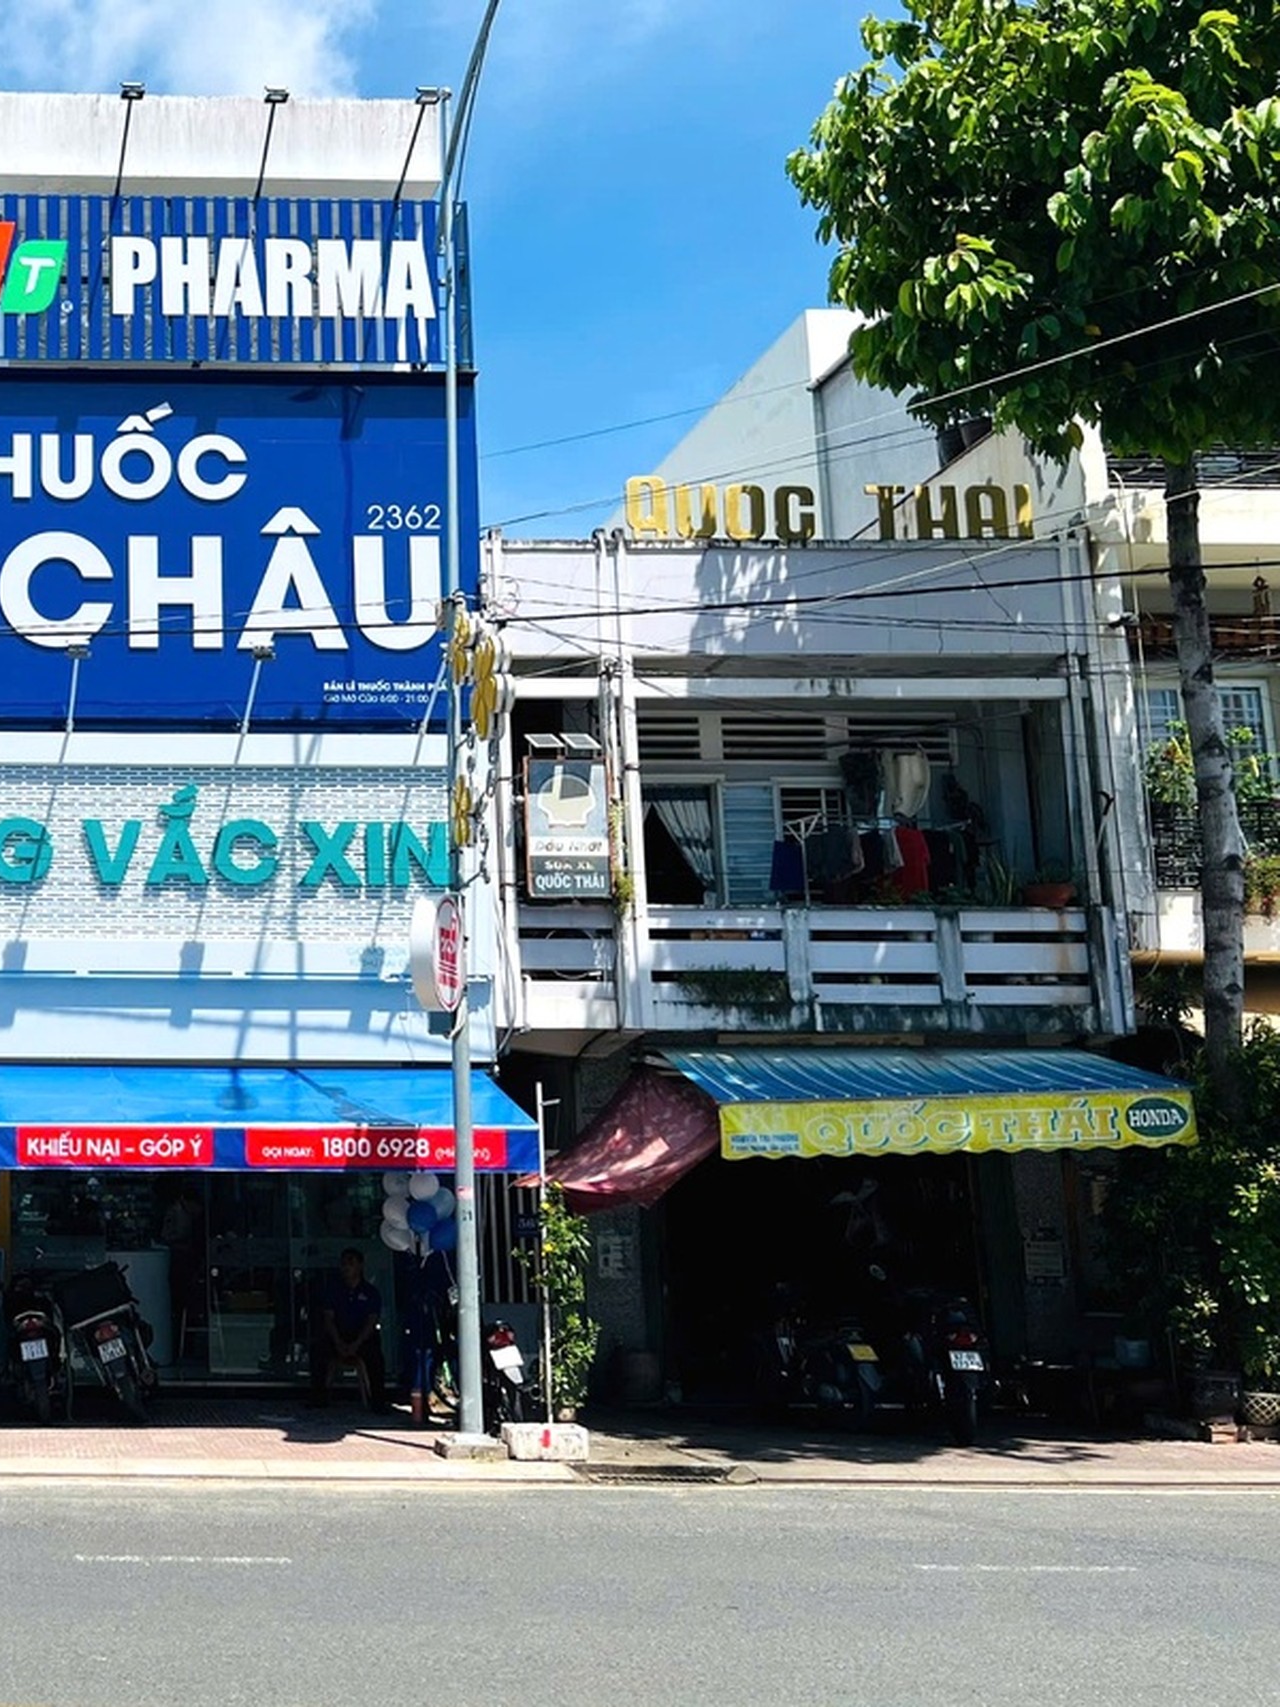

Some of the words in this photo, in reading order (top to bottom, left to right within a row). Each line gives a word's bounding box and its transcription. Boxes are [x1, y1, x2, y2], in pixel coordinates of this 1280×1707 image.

[111, 234, 437, 319] PHARMA
[366, 504, 442, 531] 2362
[535, 872, 572, 890] QUỐC
[574, 872, 605, 889] THÁI
[805, 1101, 971, 1153] QUỐC
[975, 1099, 1119, 1144] THÁI
[1128, 1108, 1184, 1128] HONDA
[26, 1131, 83, 1157] KHIẾU
[86, 1138, 120, 1163] NẠI
[138, 1134, 185, 1157] GÓP
[189, 1134, 203, 1157] Ý
[321, 1137, 371, 1158] 1800
[377, 1138, 430, 1158] 6928
